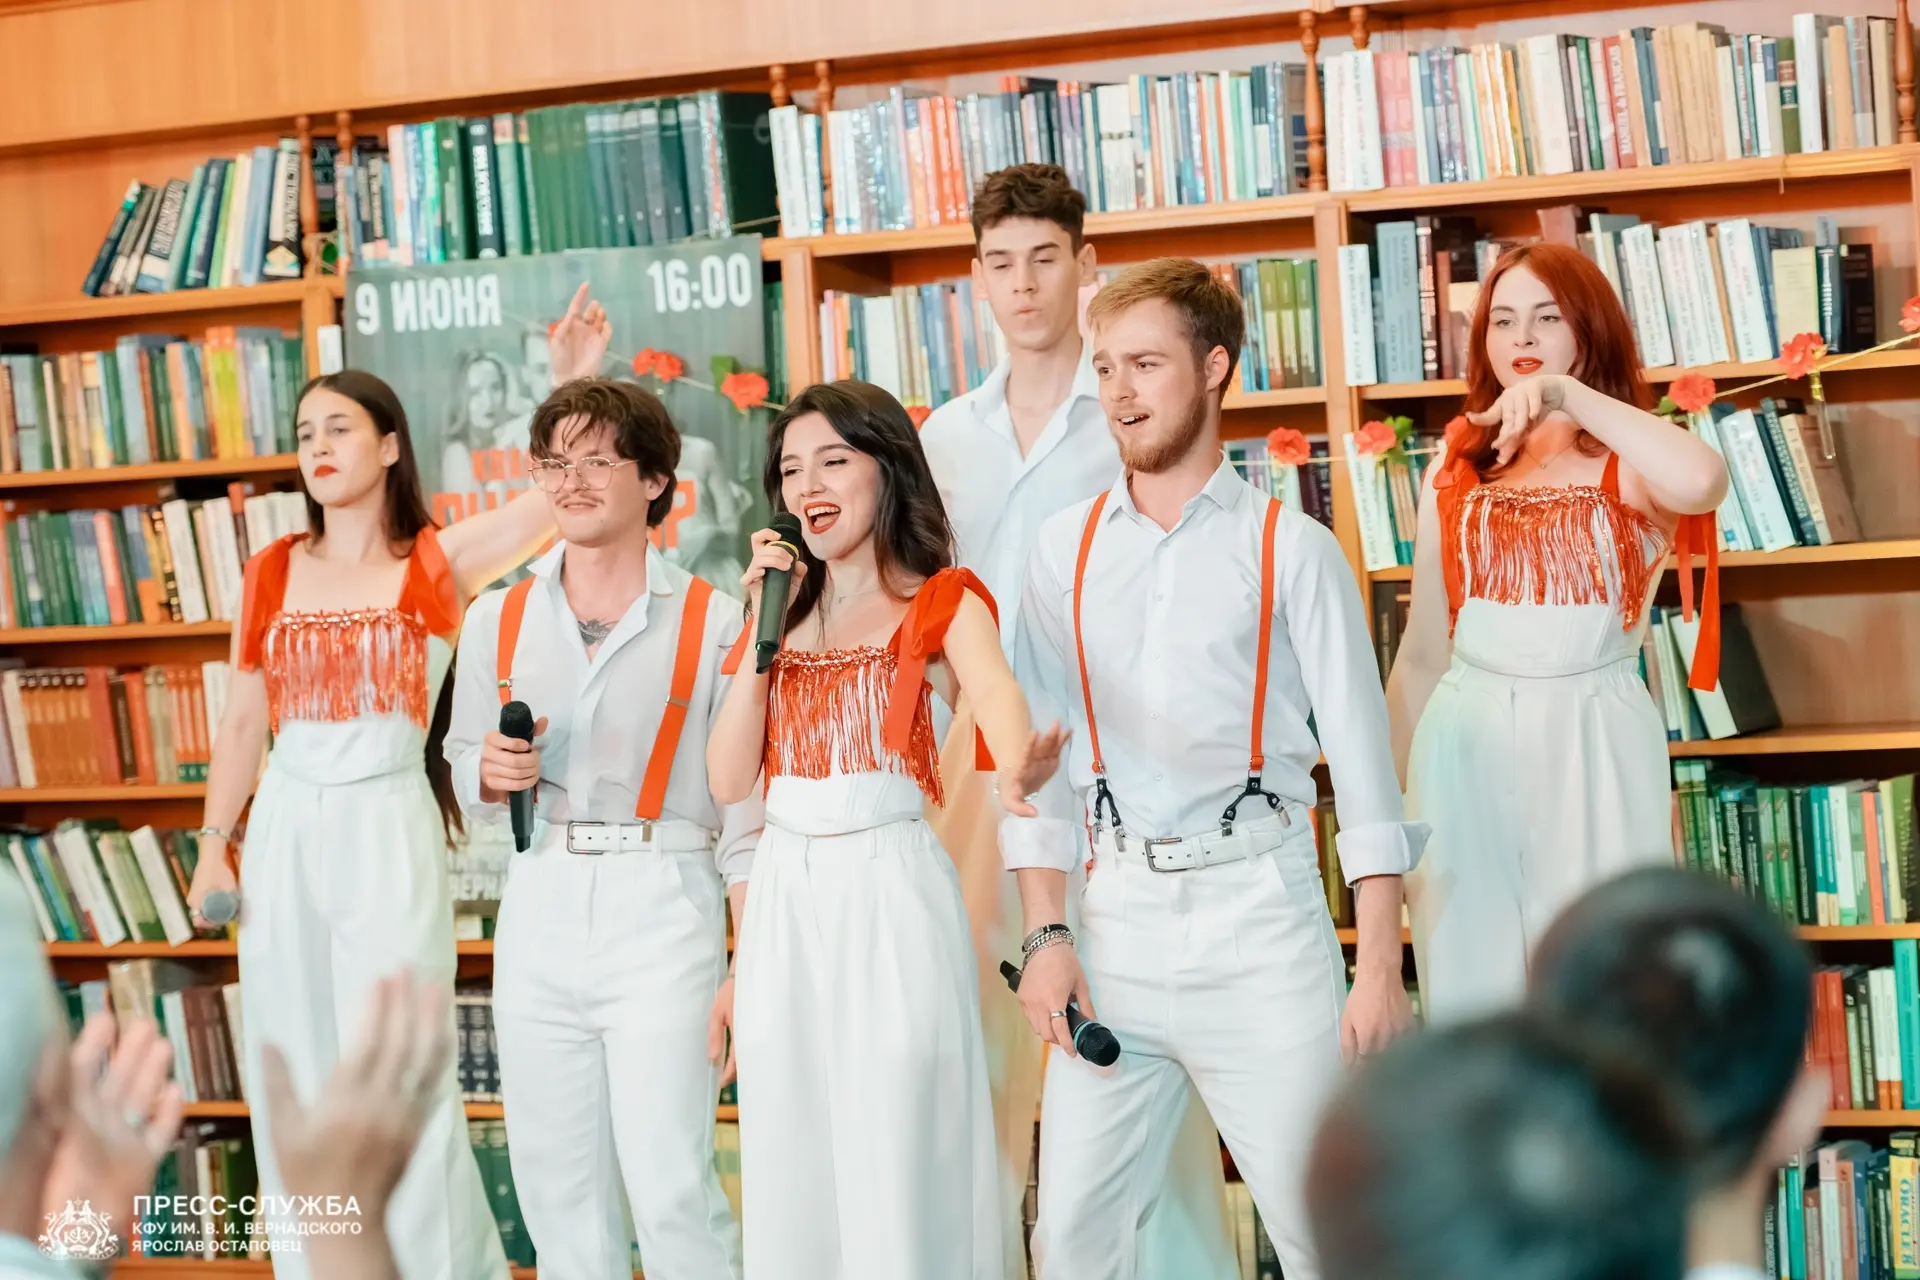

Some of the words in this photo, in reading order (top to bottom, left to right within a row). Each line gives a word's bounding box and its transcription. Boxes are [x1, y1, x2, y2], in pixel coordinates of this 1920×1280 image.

[355, 282, 380, 336] 9
[390, 273, 502, 333] ИЮНЯ
[645, 252, 752, 313] 16:00
